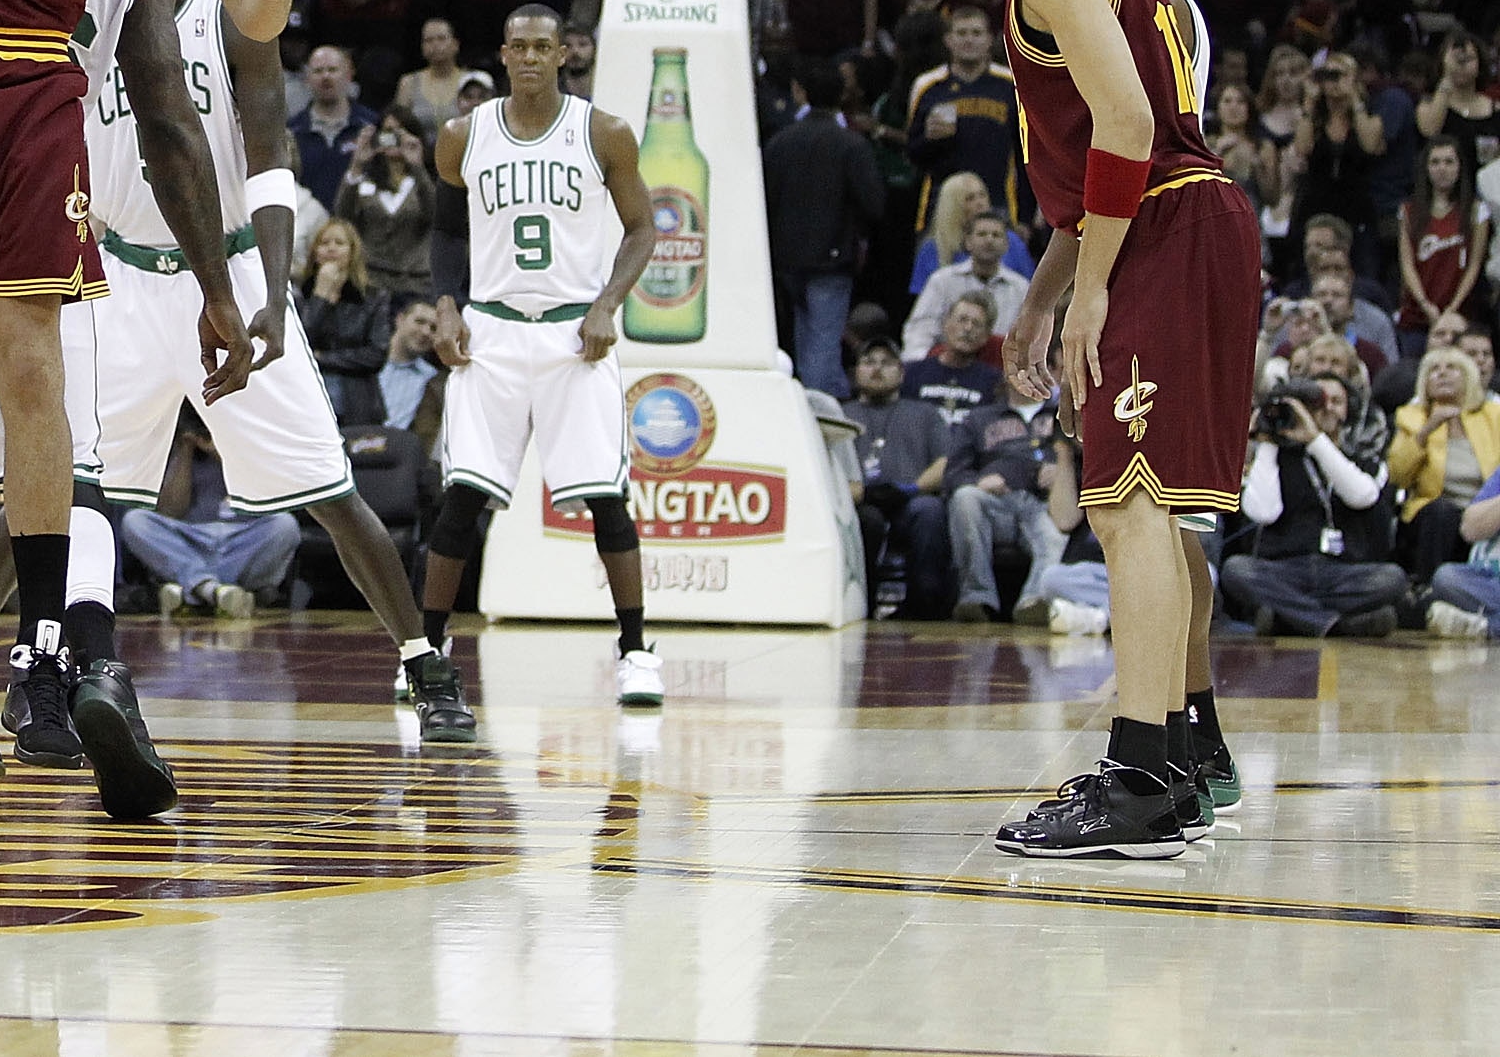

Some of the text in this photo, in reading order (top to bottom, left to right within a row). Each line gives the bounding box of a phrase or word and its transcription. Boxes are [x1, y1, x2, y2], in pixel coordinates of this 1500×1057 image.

[624, 2, 717, 23] SPALDING
[478, 160, 583, 215] CELTICS
[513, 214, 553, 271] 9
[563, 480, 771, 525] NGTAO
[643, 526, 712, 537] EER
